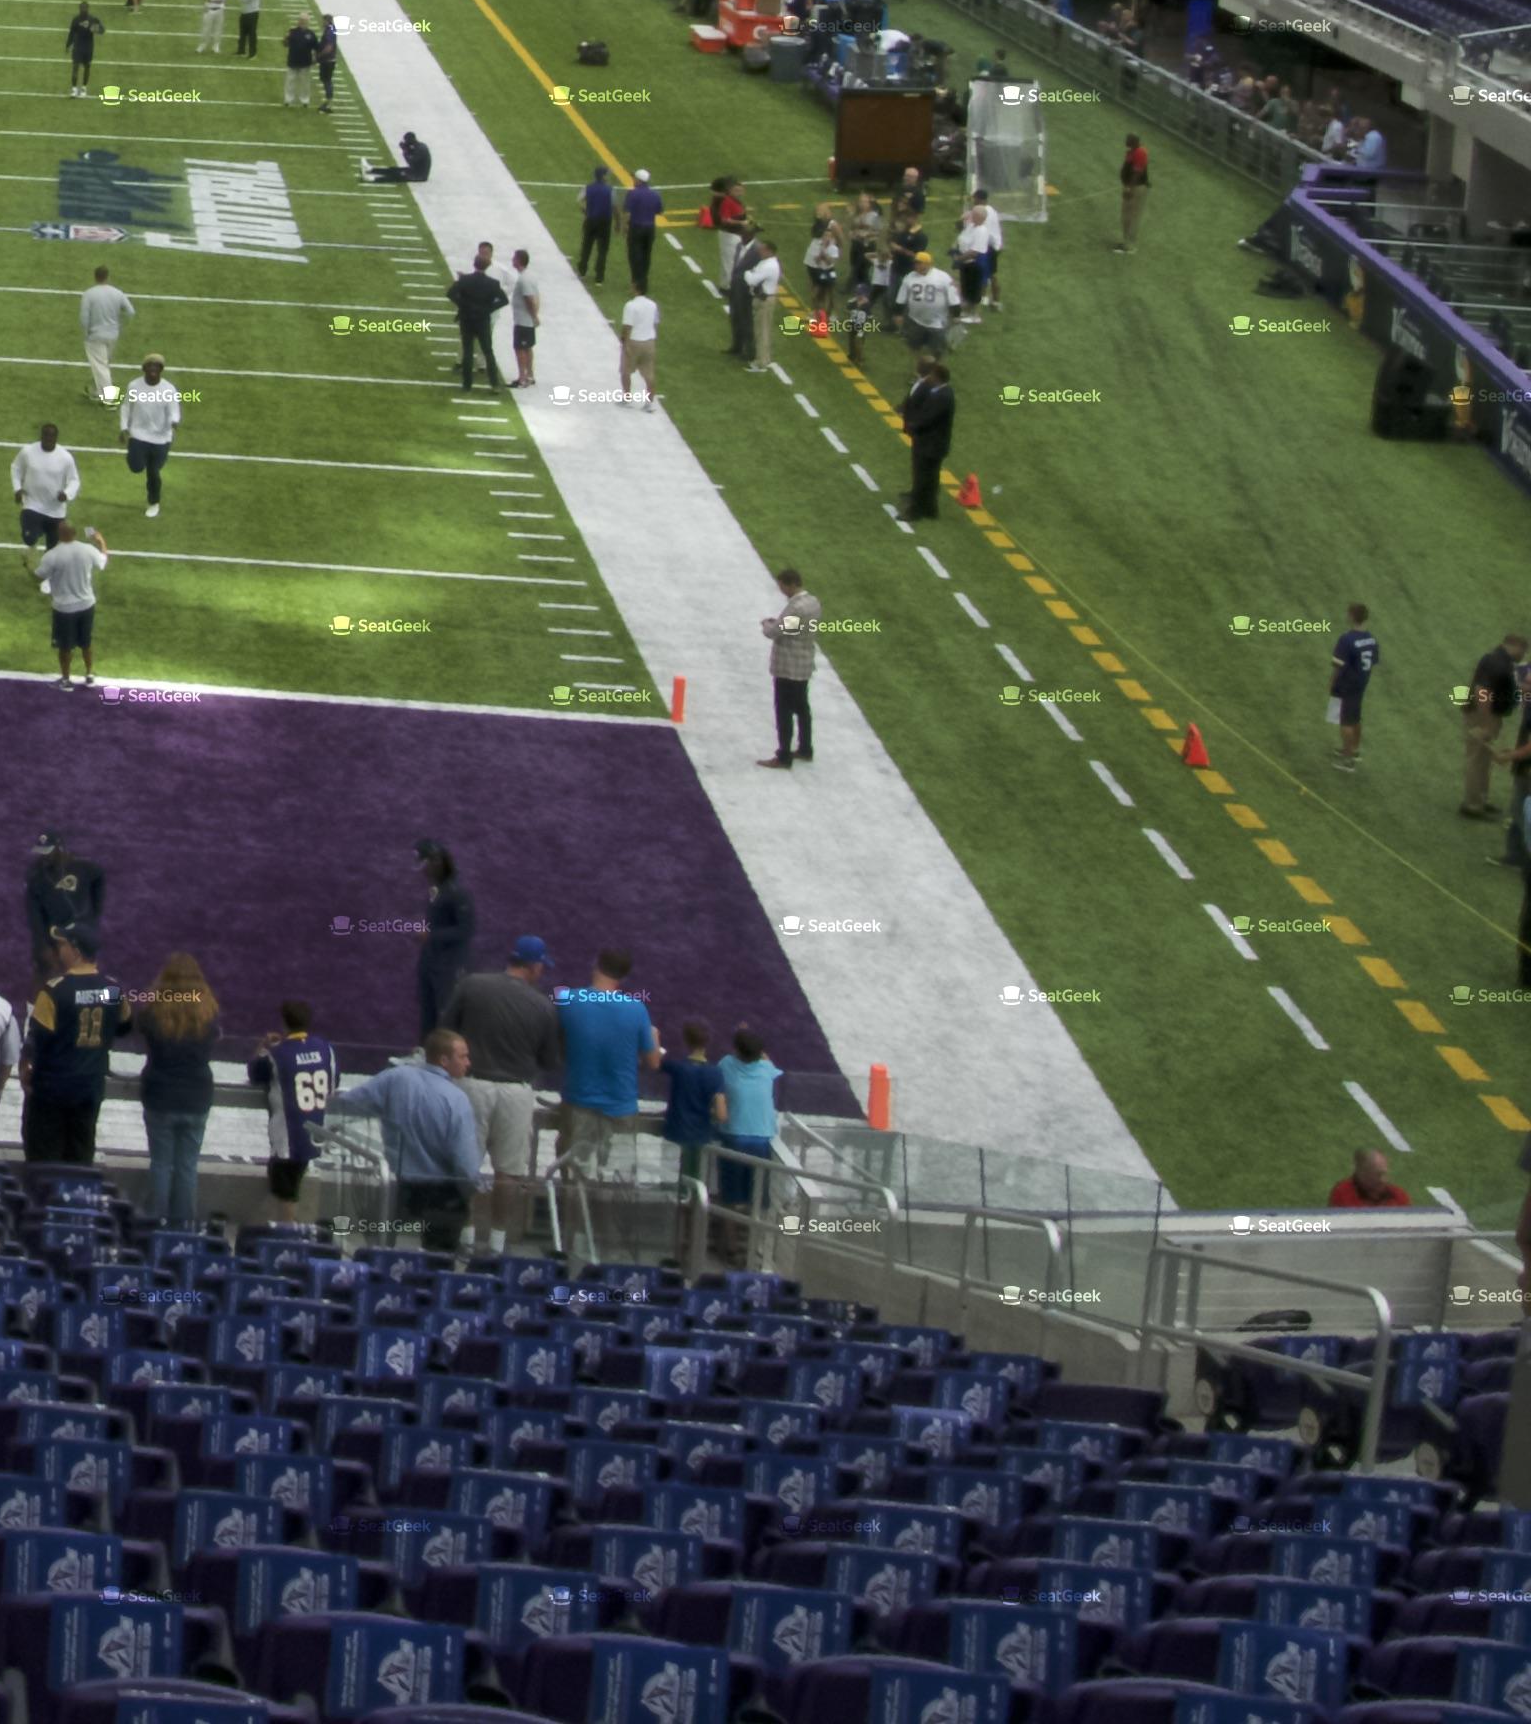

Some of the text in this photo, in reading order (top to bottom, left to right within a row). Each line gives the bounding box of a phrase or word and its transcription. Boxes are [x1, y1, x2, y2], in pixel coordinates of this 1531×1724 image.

[75, 988, 111, 1005] AUST
[75, 1007, 104, 1048] 11
[294, 1070, 329, 1112] 69
